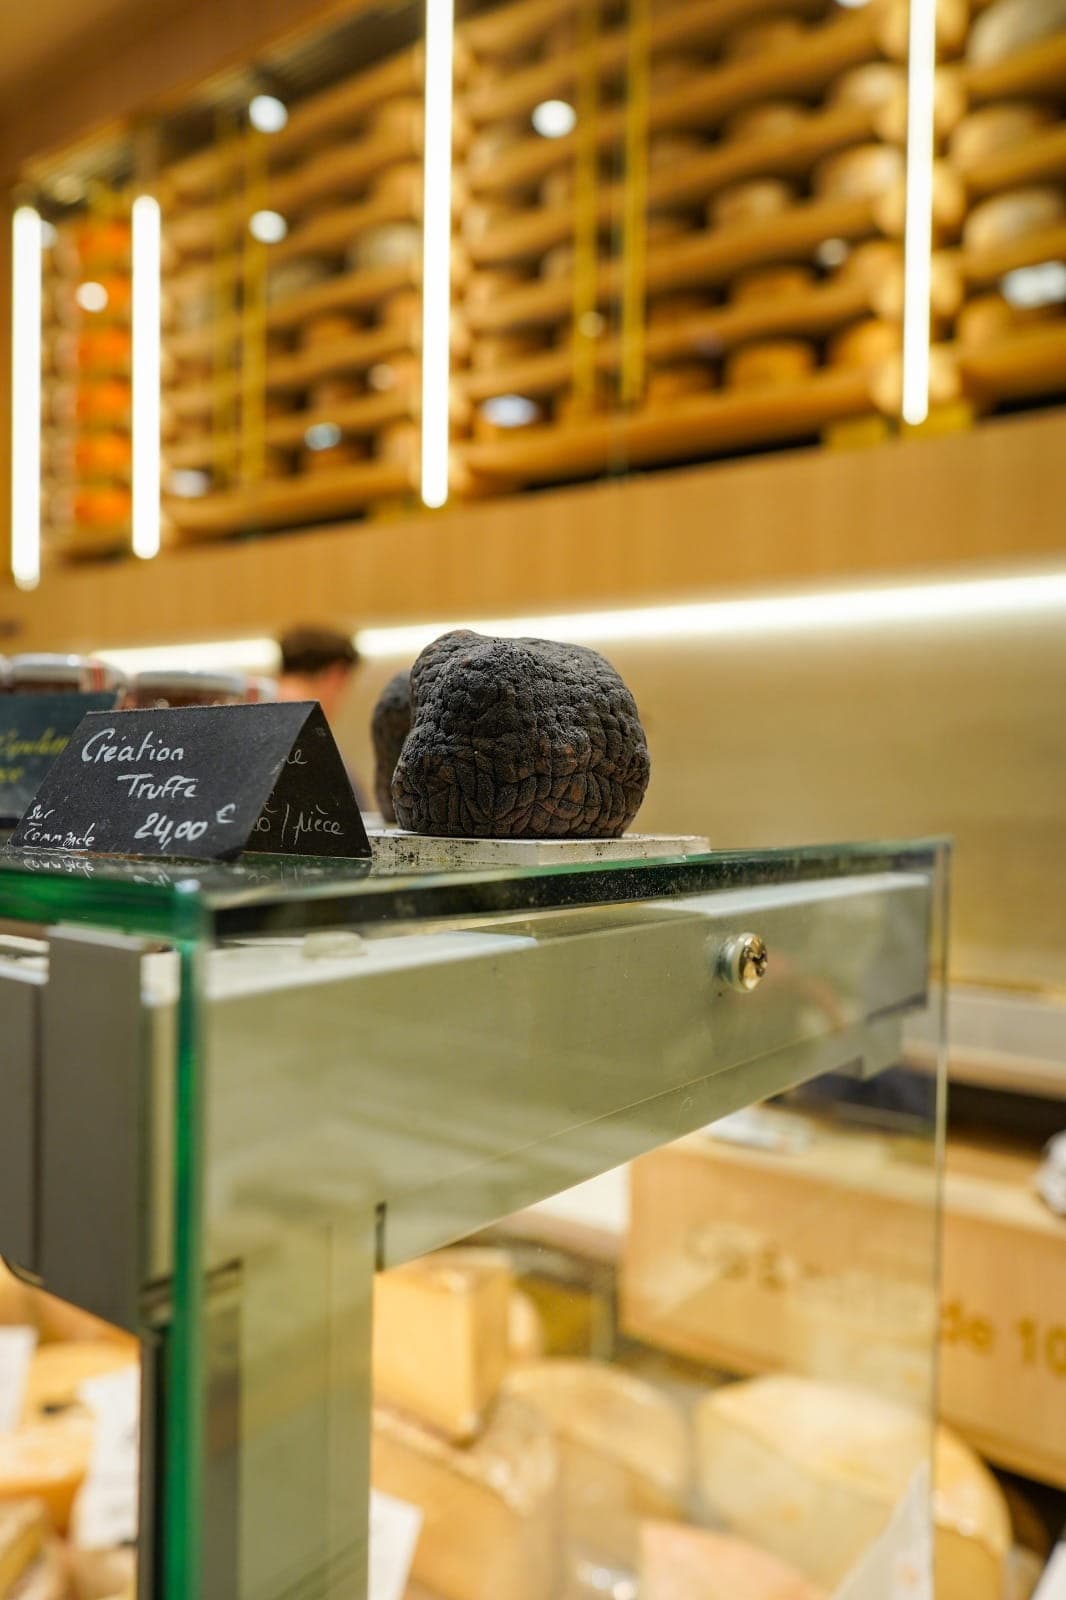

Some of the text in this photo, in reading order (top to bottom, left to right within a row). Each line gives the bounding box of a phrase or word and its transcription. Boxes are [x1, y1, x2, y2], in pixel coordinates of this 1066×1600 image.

[81, 727, 184, 763] Création
[117, 773, 199, 799] Truffe
[216, 803, 236, 824] €
